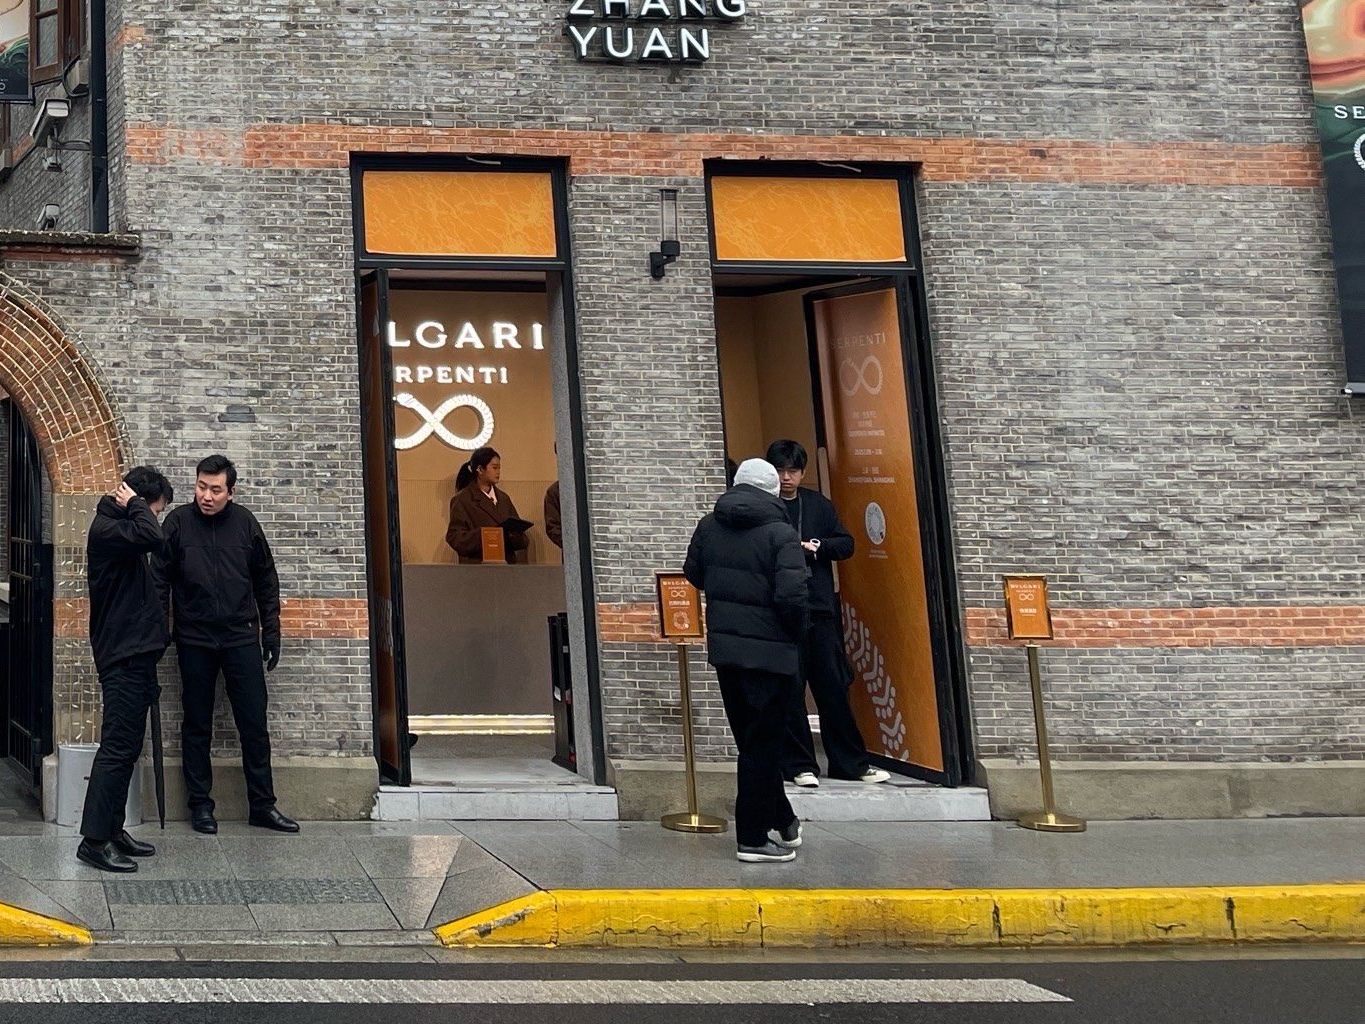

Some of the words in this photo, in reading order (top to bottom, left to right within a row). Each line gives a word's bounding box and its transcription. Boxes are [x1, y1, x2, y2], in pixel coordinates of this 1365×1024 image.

[566, 25, 711, 62] YUAN
[387, 320, 546, 350] LGARI
[395, 365, 509, 385] RPENTI
